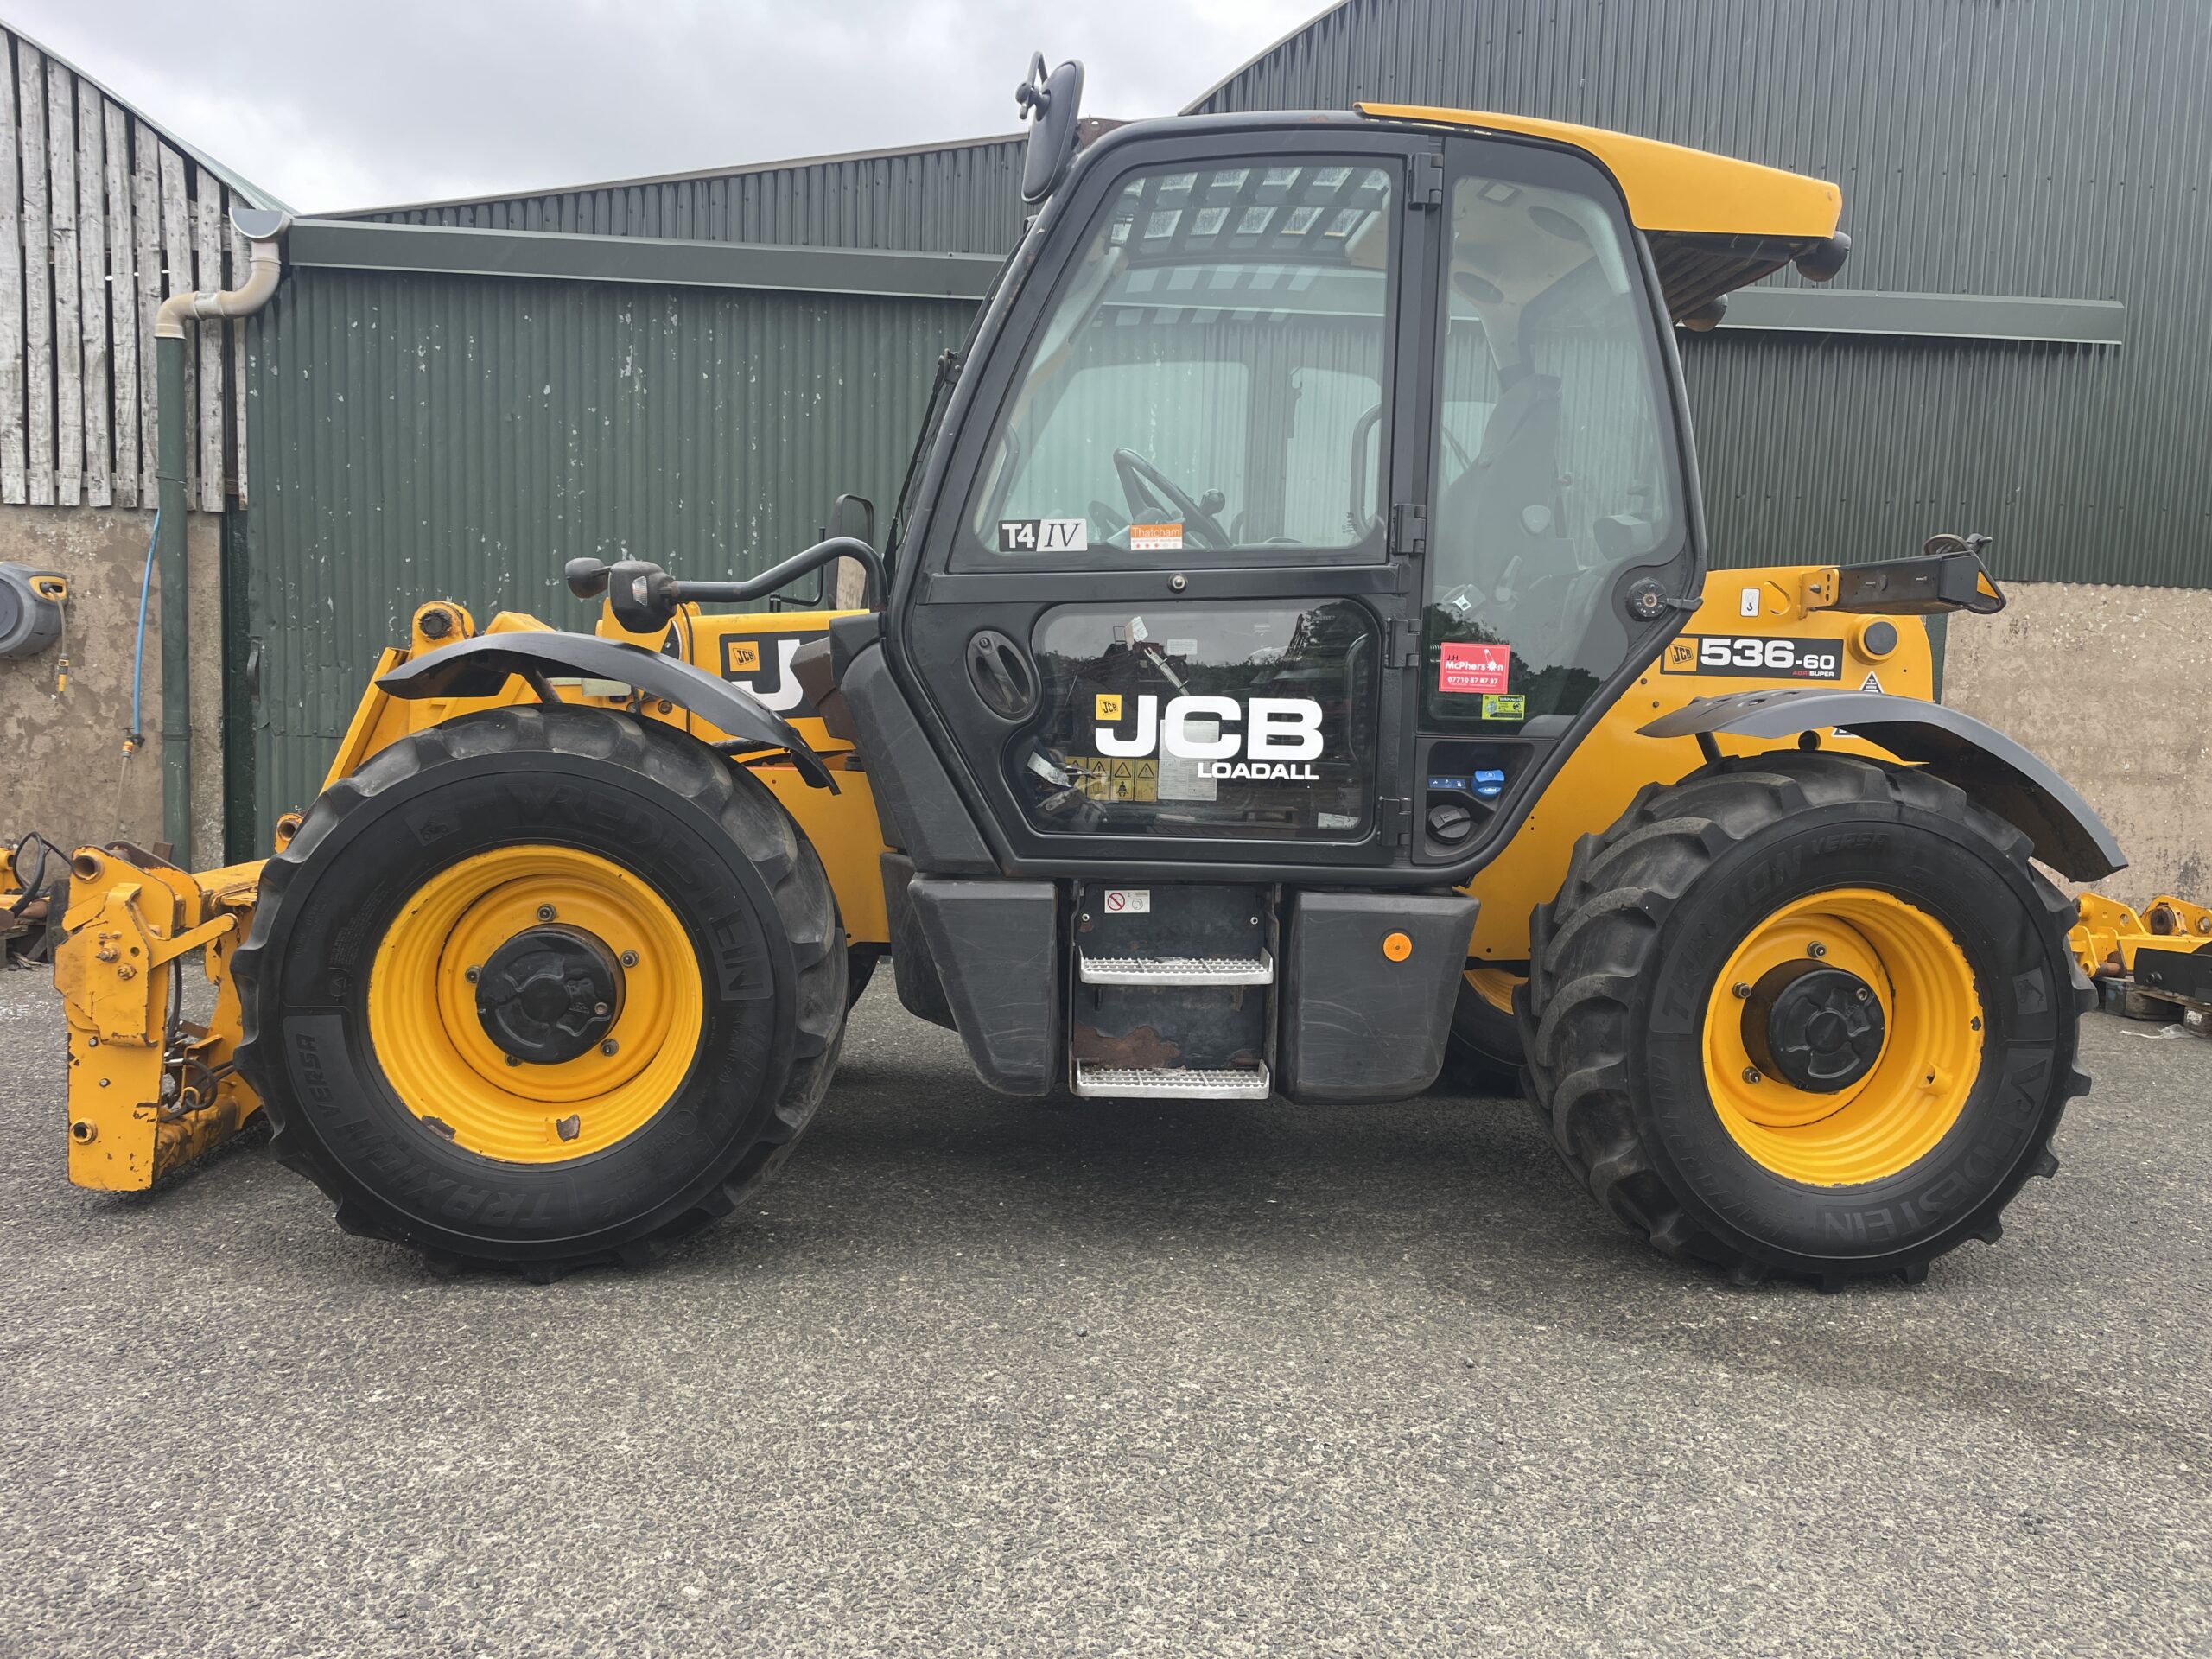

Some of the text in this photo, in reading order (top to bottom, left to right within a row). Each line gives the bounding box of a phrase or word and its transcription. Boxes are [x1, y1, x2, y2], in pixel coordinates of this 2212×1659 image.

[1001, 522, 1082, 549] T4 IV
[1133, 528, 1180, 537] Thatcham
[736, 649, 755, 664] JCB
[1673, 645, 1693, 662] JCB
[1700, 638, 1835, 669] 536-60
[1103, 702, 1117, 714] JCB
[1095, 694, 1324, 761] JCB
[1198, 762, 1319, 780] LOADALL
[294, 1032, 342, 1122] VERSA
